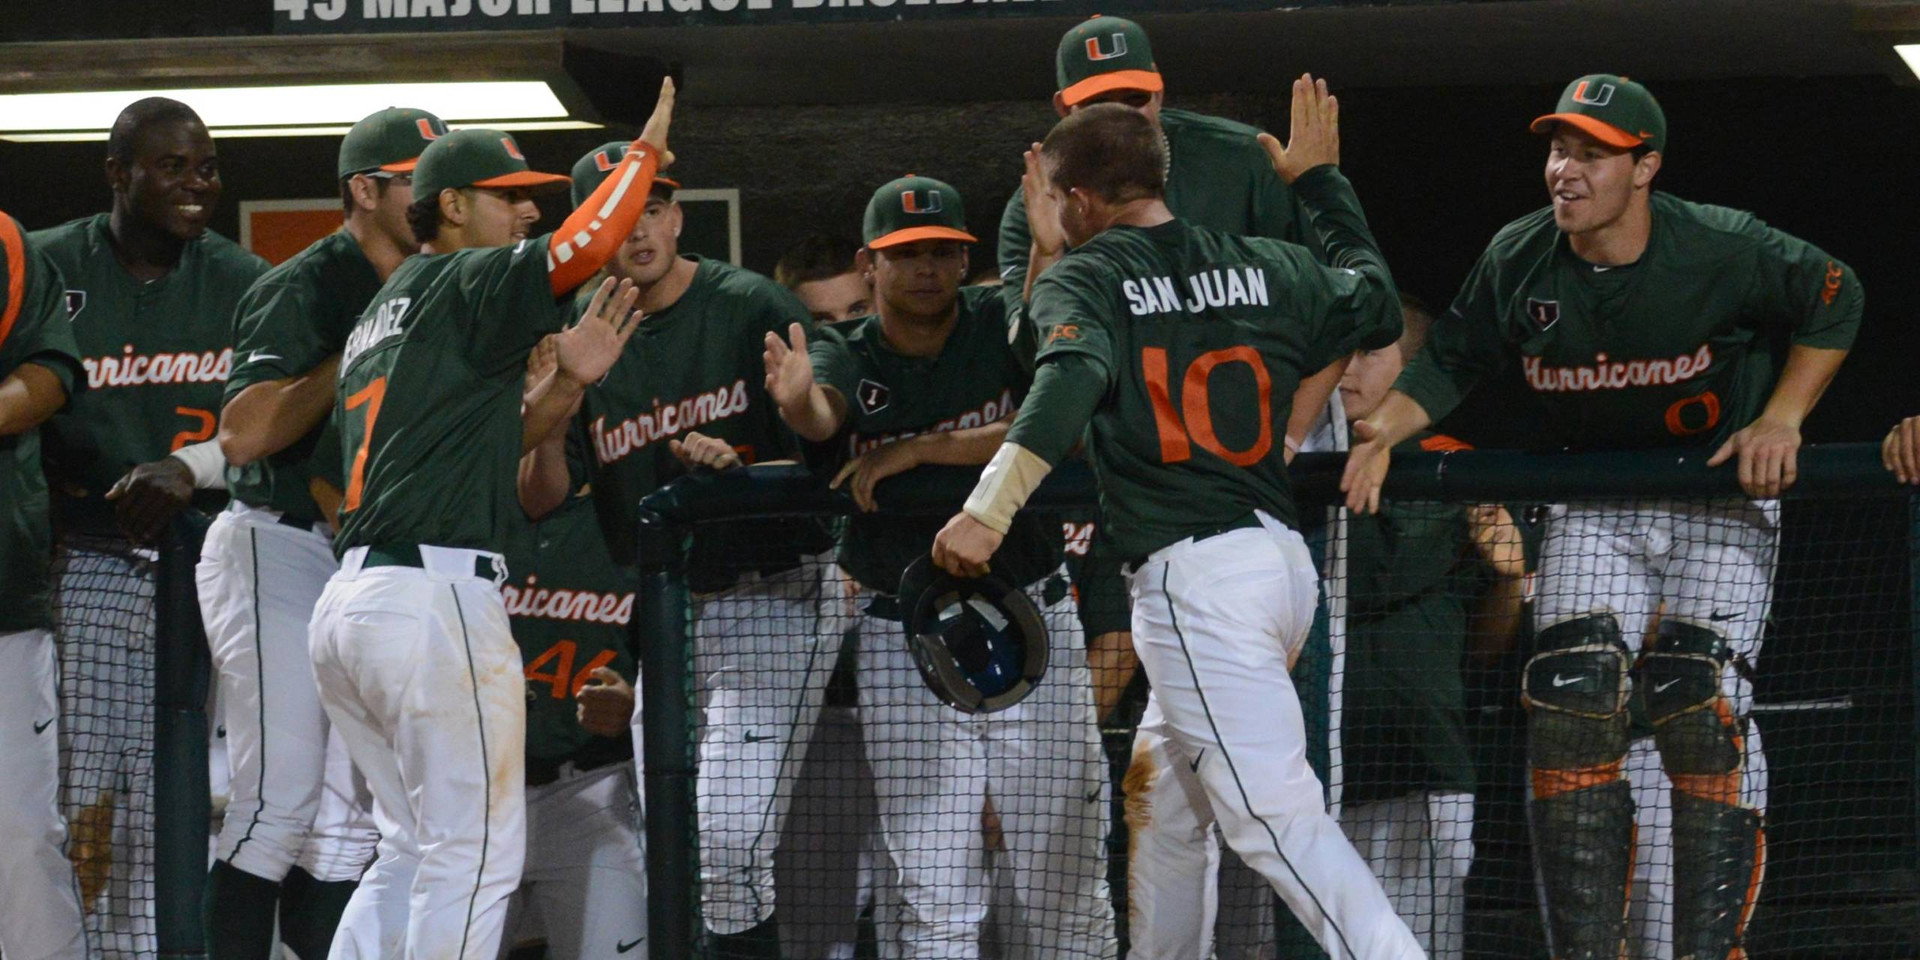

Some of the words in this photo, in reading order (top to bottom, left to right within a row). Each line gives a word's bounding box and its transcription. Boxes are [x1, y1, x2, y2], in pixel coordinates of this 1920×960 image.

[1085, 33, 1128, 61] U
[1572, 80, 1615, 106] U
[901, 190, 942, 213] U
[1122, 276, 1182, 316] SAN
[1186, 267, 1269, 314] JUAN
[83, 344, 233, 389] rricanes
[1522, 343, 1713, 392] Hurricanes
[867, 388, 878, 406] 1
[1141, 344, 1272, 467] 10
[345, 375, 388, 513] 7
[502, 573, 636, 625] ricanes
